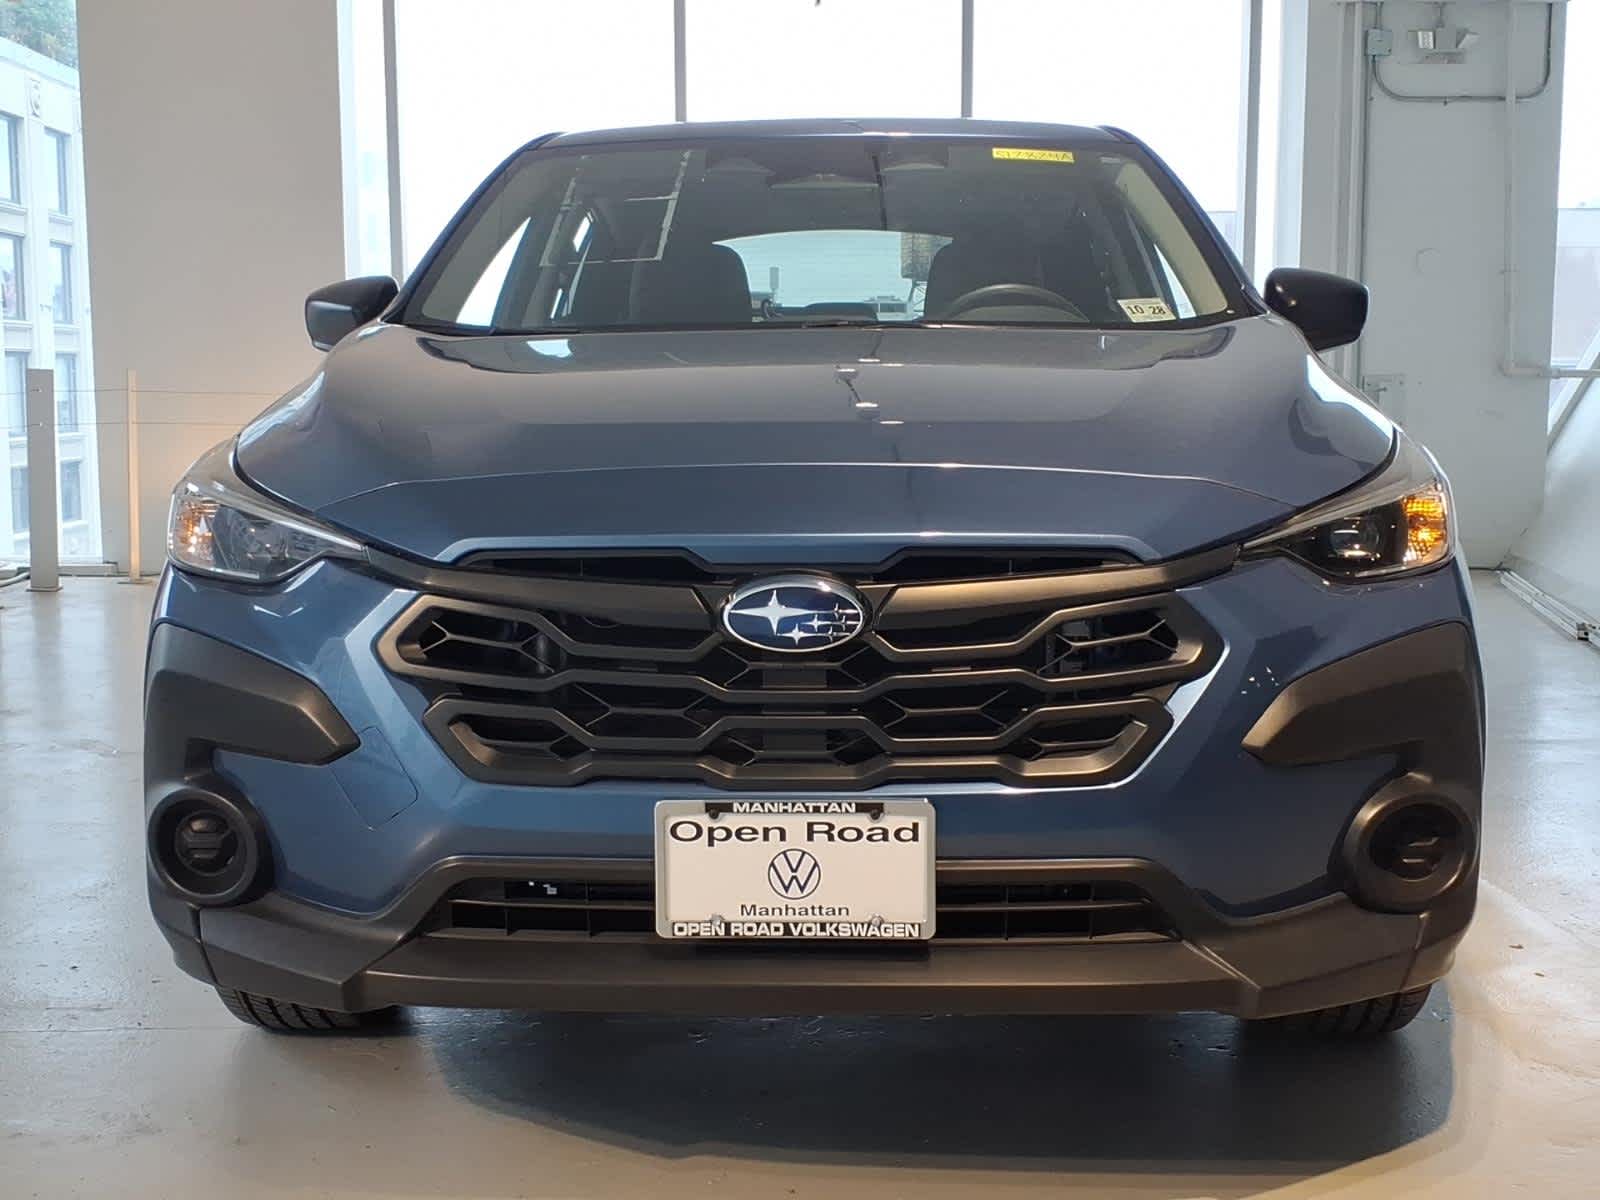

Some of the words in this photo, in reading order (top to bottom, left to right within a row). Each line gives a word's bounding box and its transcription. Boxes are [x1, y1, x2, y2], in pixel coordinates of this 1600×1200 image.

[1127, 305, 1145, 315] 10
[1148, 305, 1166, 315] 28
[732, 802, 856, 813] MANHATTAN
[669, 820, 787, 847] Open
[806, 822, 919, 842] Road
[768, 848, 821, 900] VW
[740, 903, 849, 917] Manhattan
[673, 922, 725, 936] OPEN
[730, 922, 784, 936] ROAD
[791, 922, 920, 937] VOLKSWAGEN
